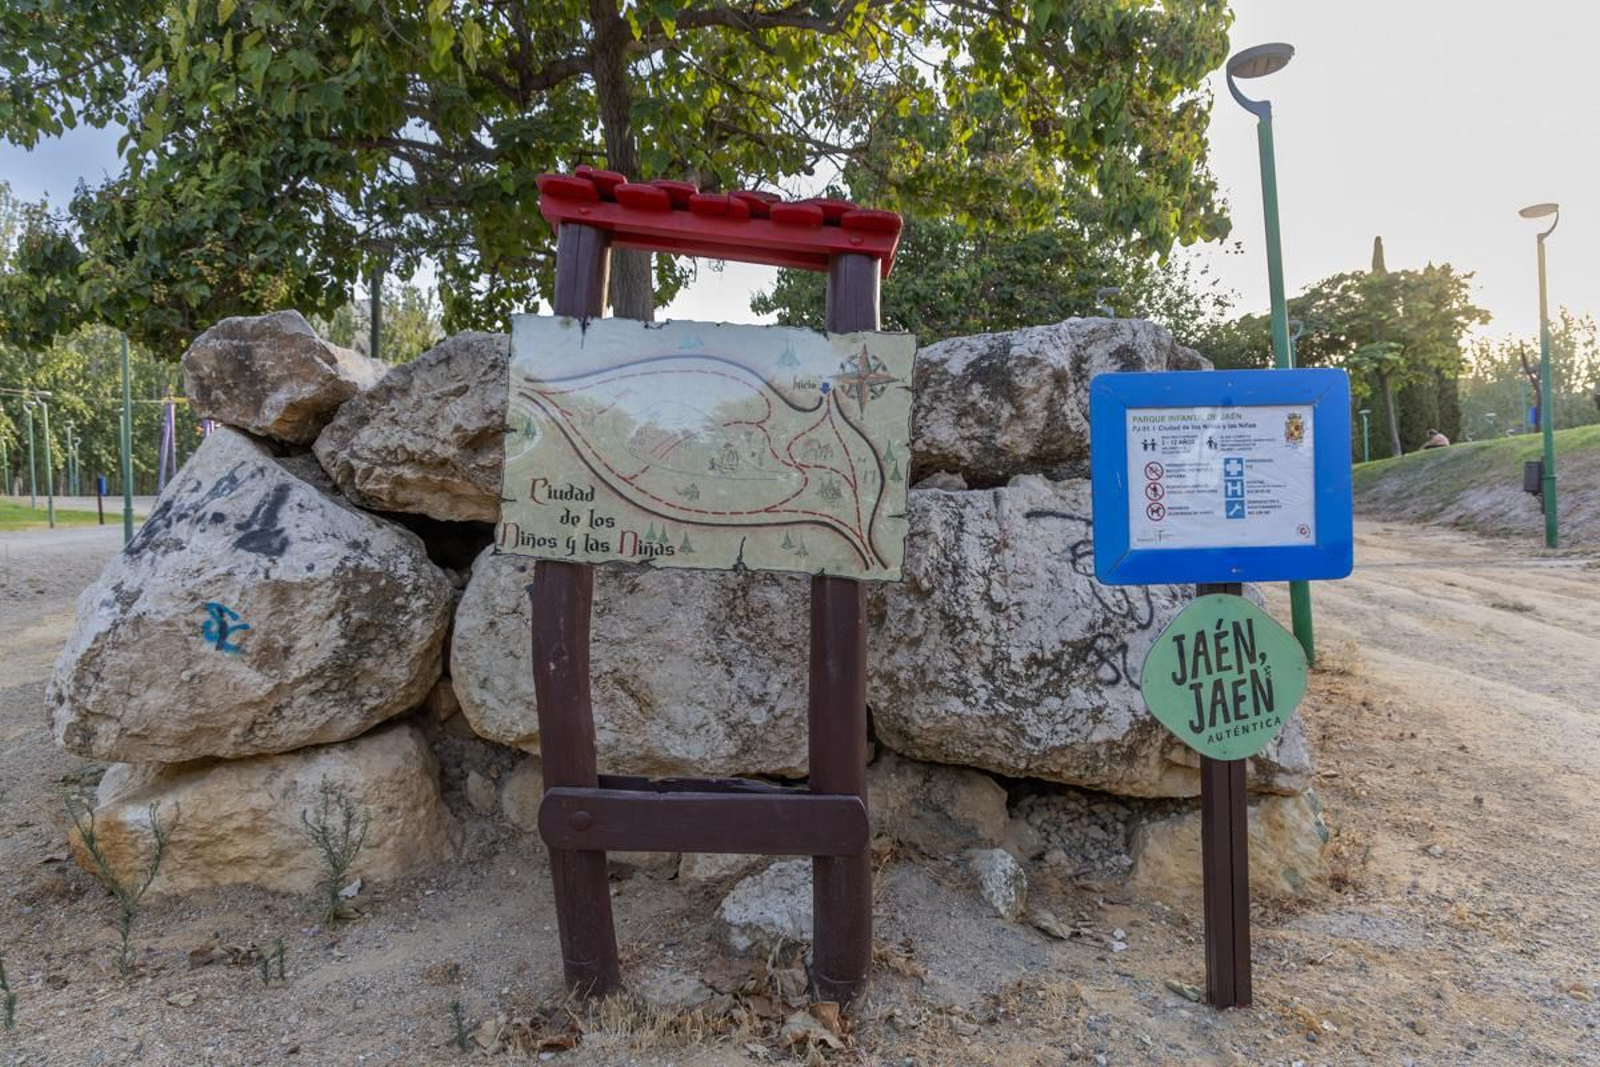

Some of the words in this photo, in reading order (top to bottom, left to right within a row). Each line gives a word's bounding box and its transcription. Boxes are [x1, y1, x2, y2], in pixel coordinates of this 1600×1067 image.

[1132, 415, 1163, 423] PARQUE
[1167, 414, 1204, 422] INFANT
[1158, 424, 1180, 432] Ciudad
[1238, 421, 1257, 429] Niñas
[530, 477, 595, 506] Ciudad
[559, 507, 581, 527] de
[589, 508, 616, 530] los
[501, 522, 558, 549] Niños
[565, 535, 577, 556] y
[584, 533, 610, 554] las
[619, 530, 676, 560] Niñas
[1171, 618, 1268, 686] JAÉN,
[1207, 716, 1281, 745] AUTÉNTICA
